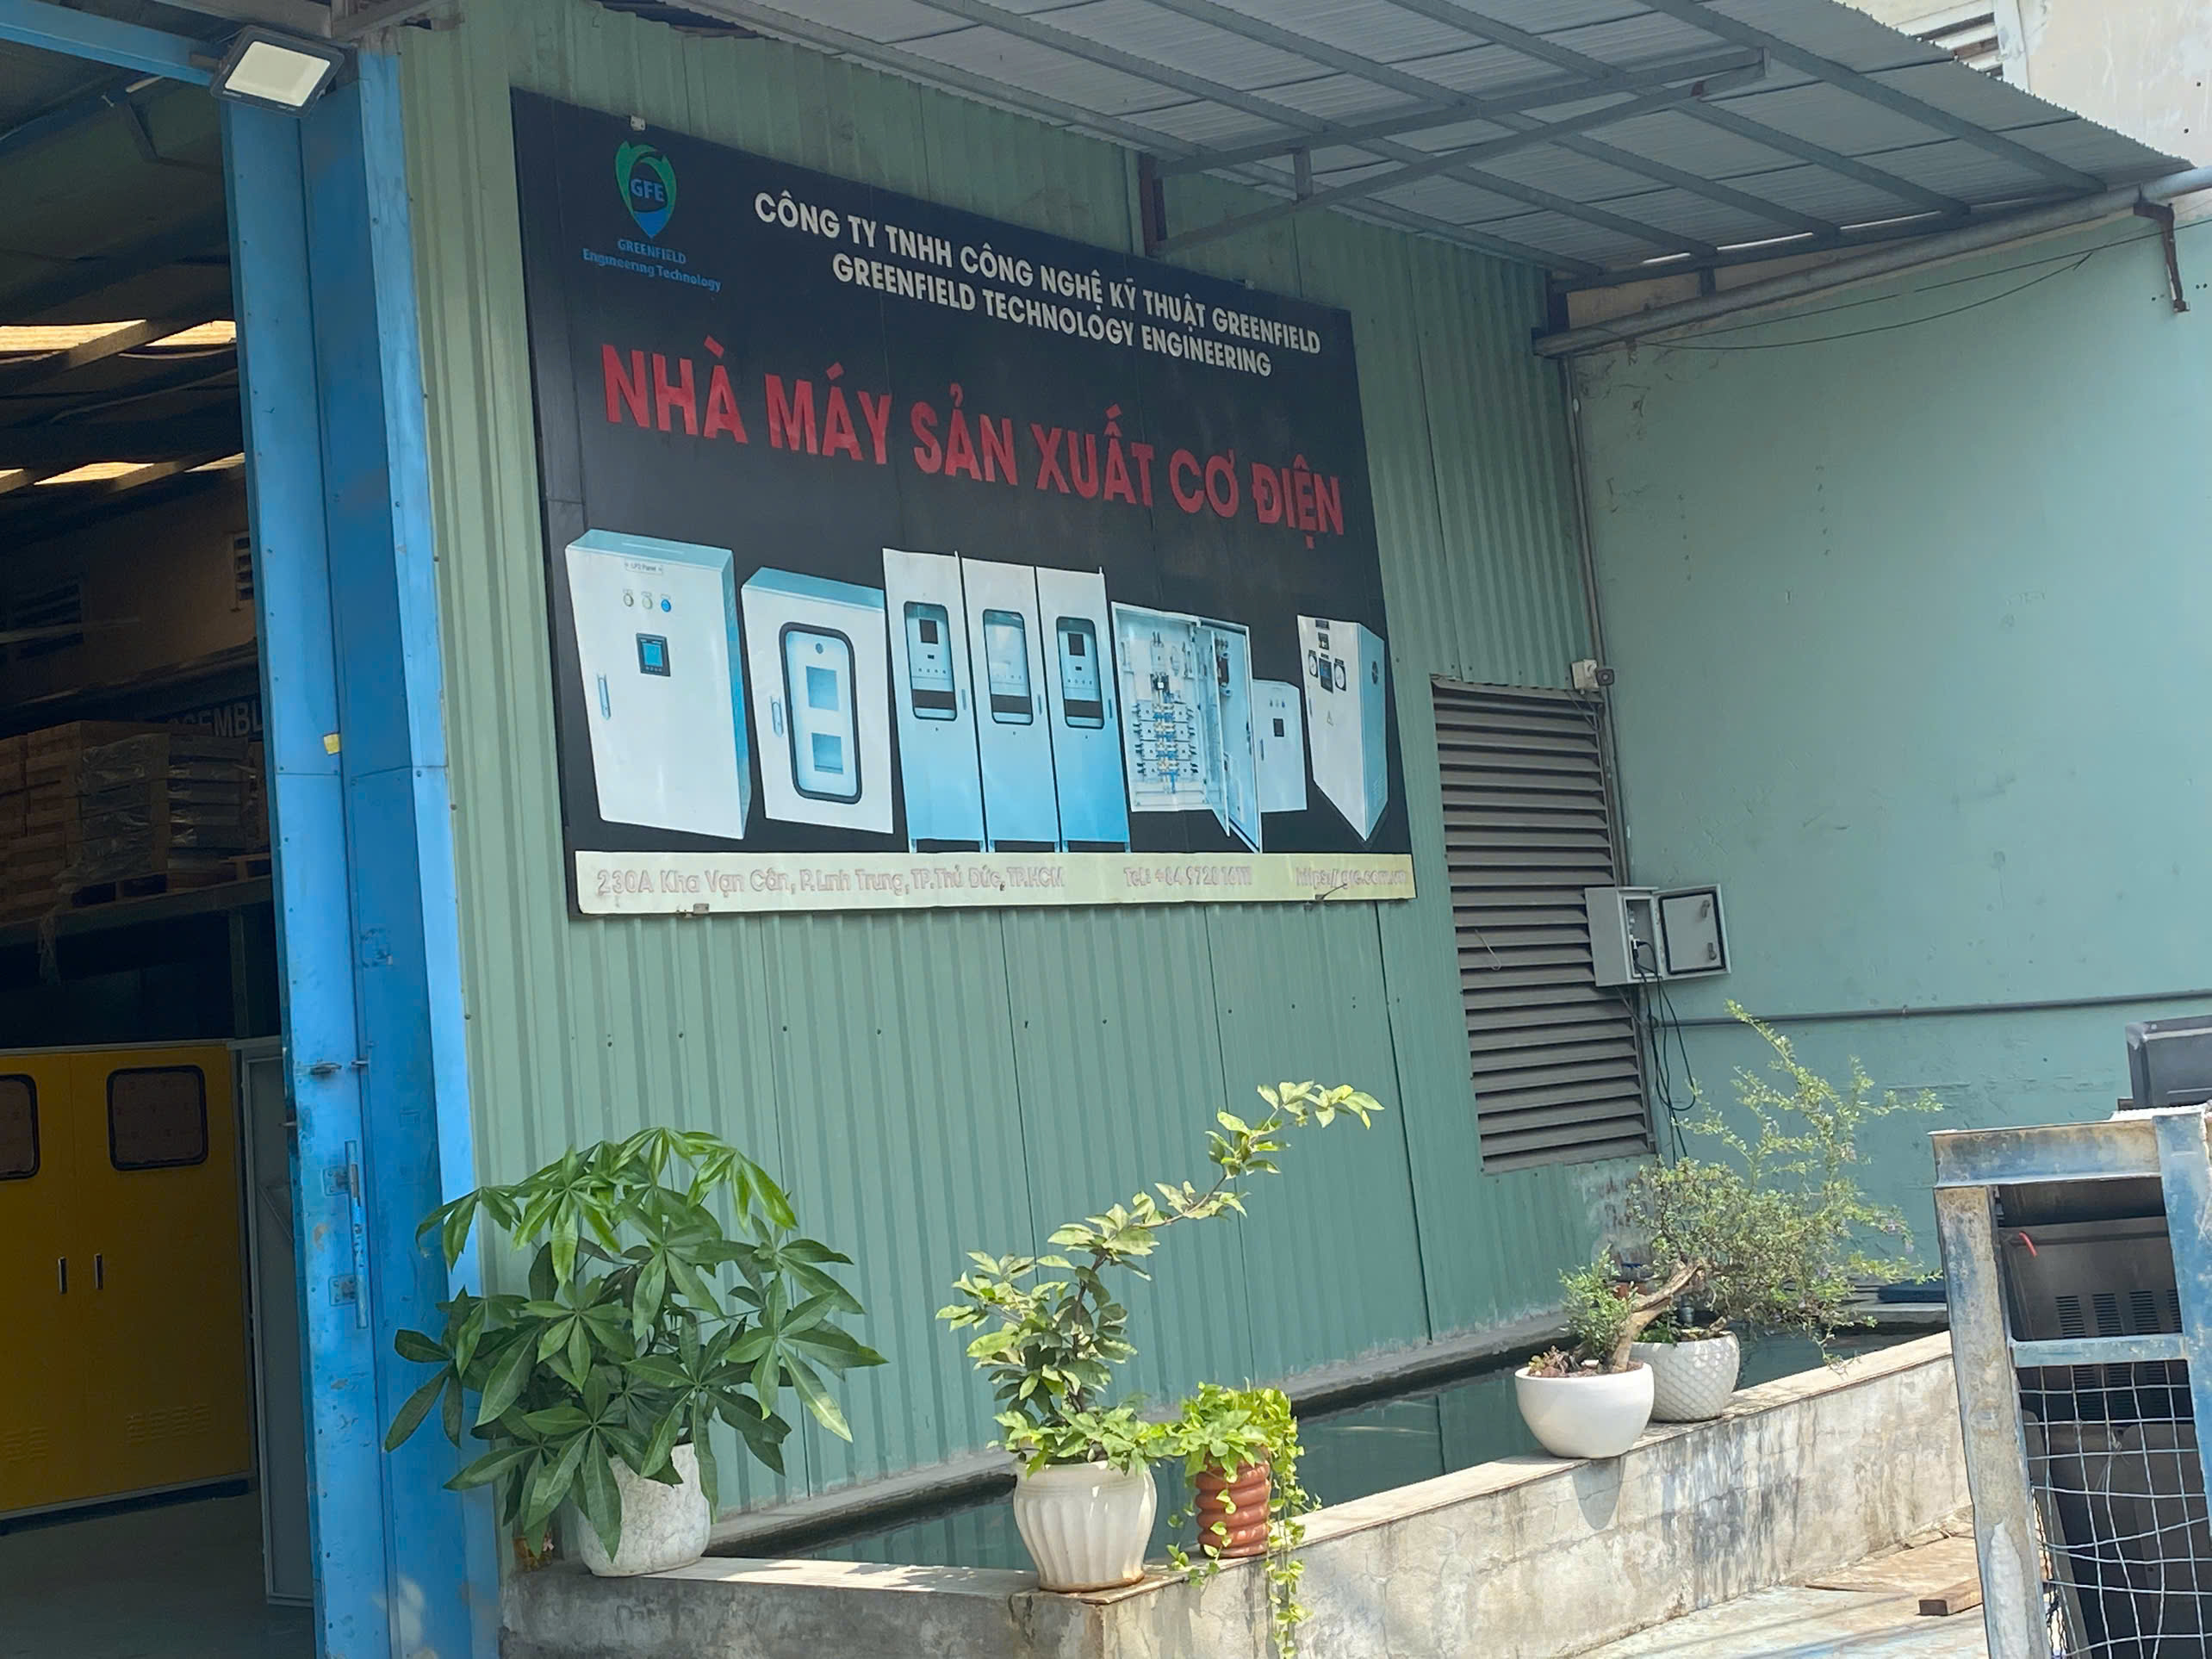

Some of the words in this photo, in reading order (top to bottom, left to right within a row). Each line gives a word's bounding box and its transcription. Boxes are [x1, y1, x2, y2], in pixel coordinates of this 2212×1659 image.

[631, 178, 664, 202] GFE
[583, 247, 655, 278] Engineering
[657, 265, 721, 293] Technology
[618, 238, 687, 264] GREENFIELD
[755, 190, 840, 239] CÔNG
[848, 214, 877, 248] TY
[885, 225, 953, 268] TNHH
[960, 243, 1034, 287] CÔNG
[1040, 265, 1103, 311] NGHỆ
[1109, 277, 1136, 311] KỸ
[1142, 289, 1206, 333] THUẬT
[1212, 308, 1320, 353] GREENFIELD
[832, 253, 976, 311] GREENFIELD
[982, 289, 1134, 346] TECHNOLOGY
[1141, 325, 1271, 376] ENGINEERING
[601, 336, 748, 444] NHÀ
[764, 363, 892, 465] MÁY
[910, 383, 1018, 486] SẢN
[1030, 404, 1154, 506] XUẤT
[1169, 448, 1239, 518] CƠ
[1252, 455, 1344, 549] ĐIỆN
[596, 869, 655, 895] 230A
[660, 869, 701, 893] Kha
[705, 869, 745, 898] Vạn
